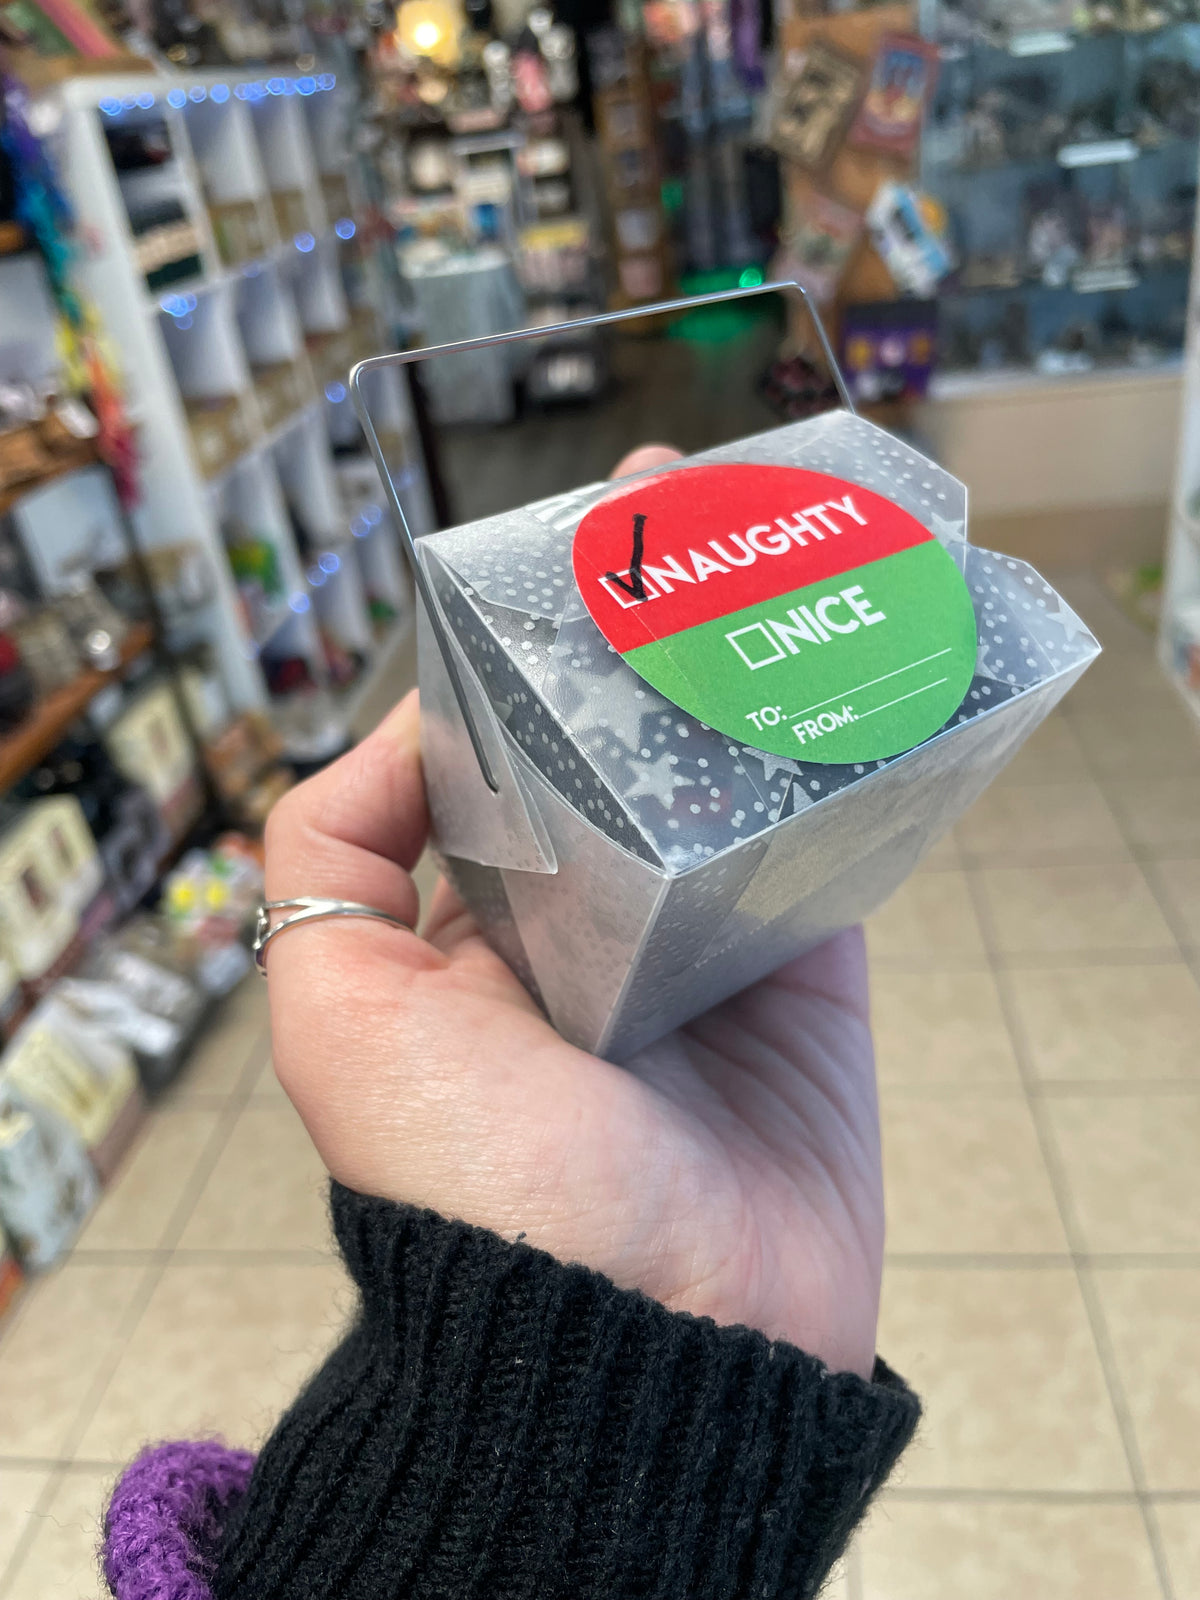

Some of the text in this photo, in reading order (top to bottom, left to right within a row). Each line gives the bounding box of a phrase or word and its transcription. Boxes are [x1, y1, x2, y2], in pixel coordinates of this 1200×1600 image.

[640, 495, 868, 594] NAUGHTY
[765, 585, 887, 655] NICE
[745, 705, 788, 731] TO:
[791, 704, 860, 745] FROM:
